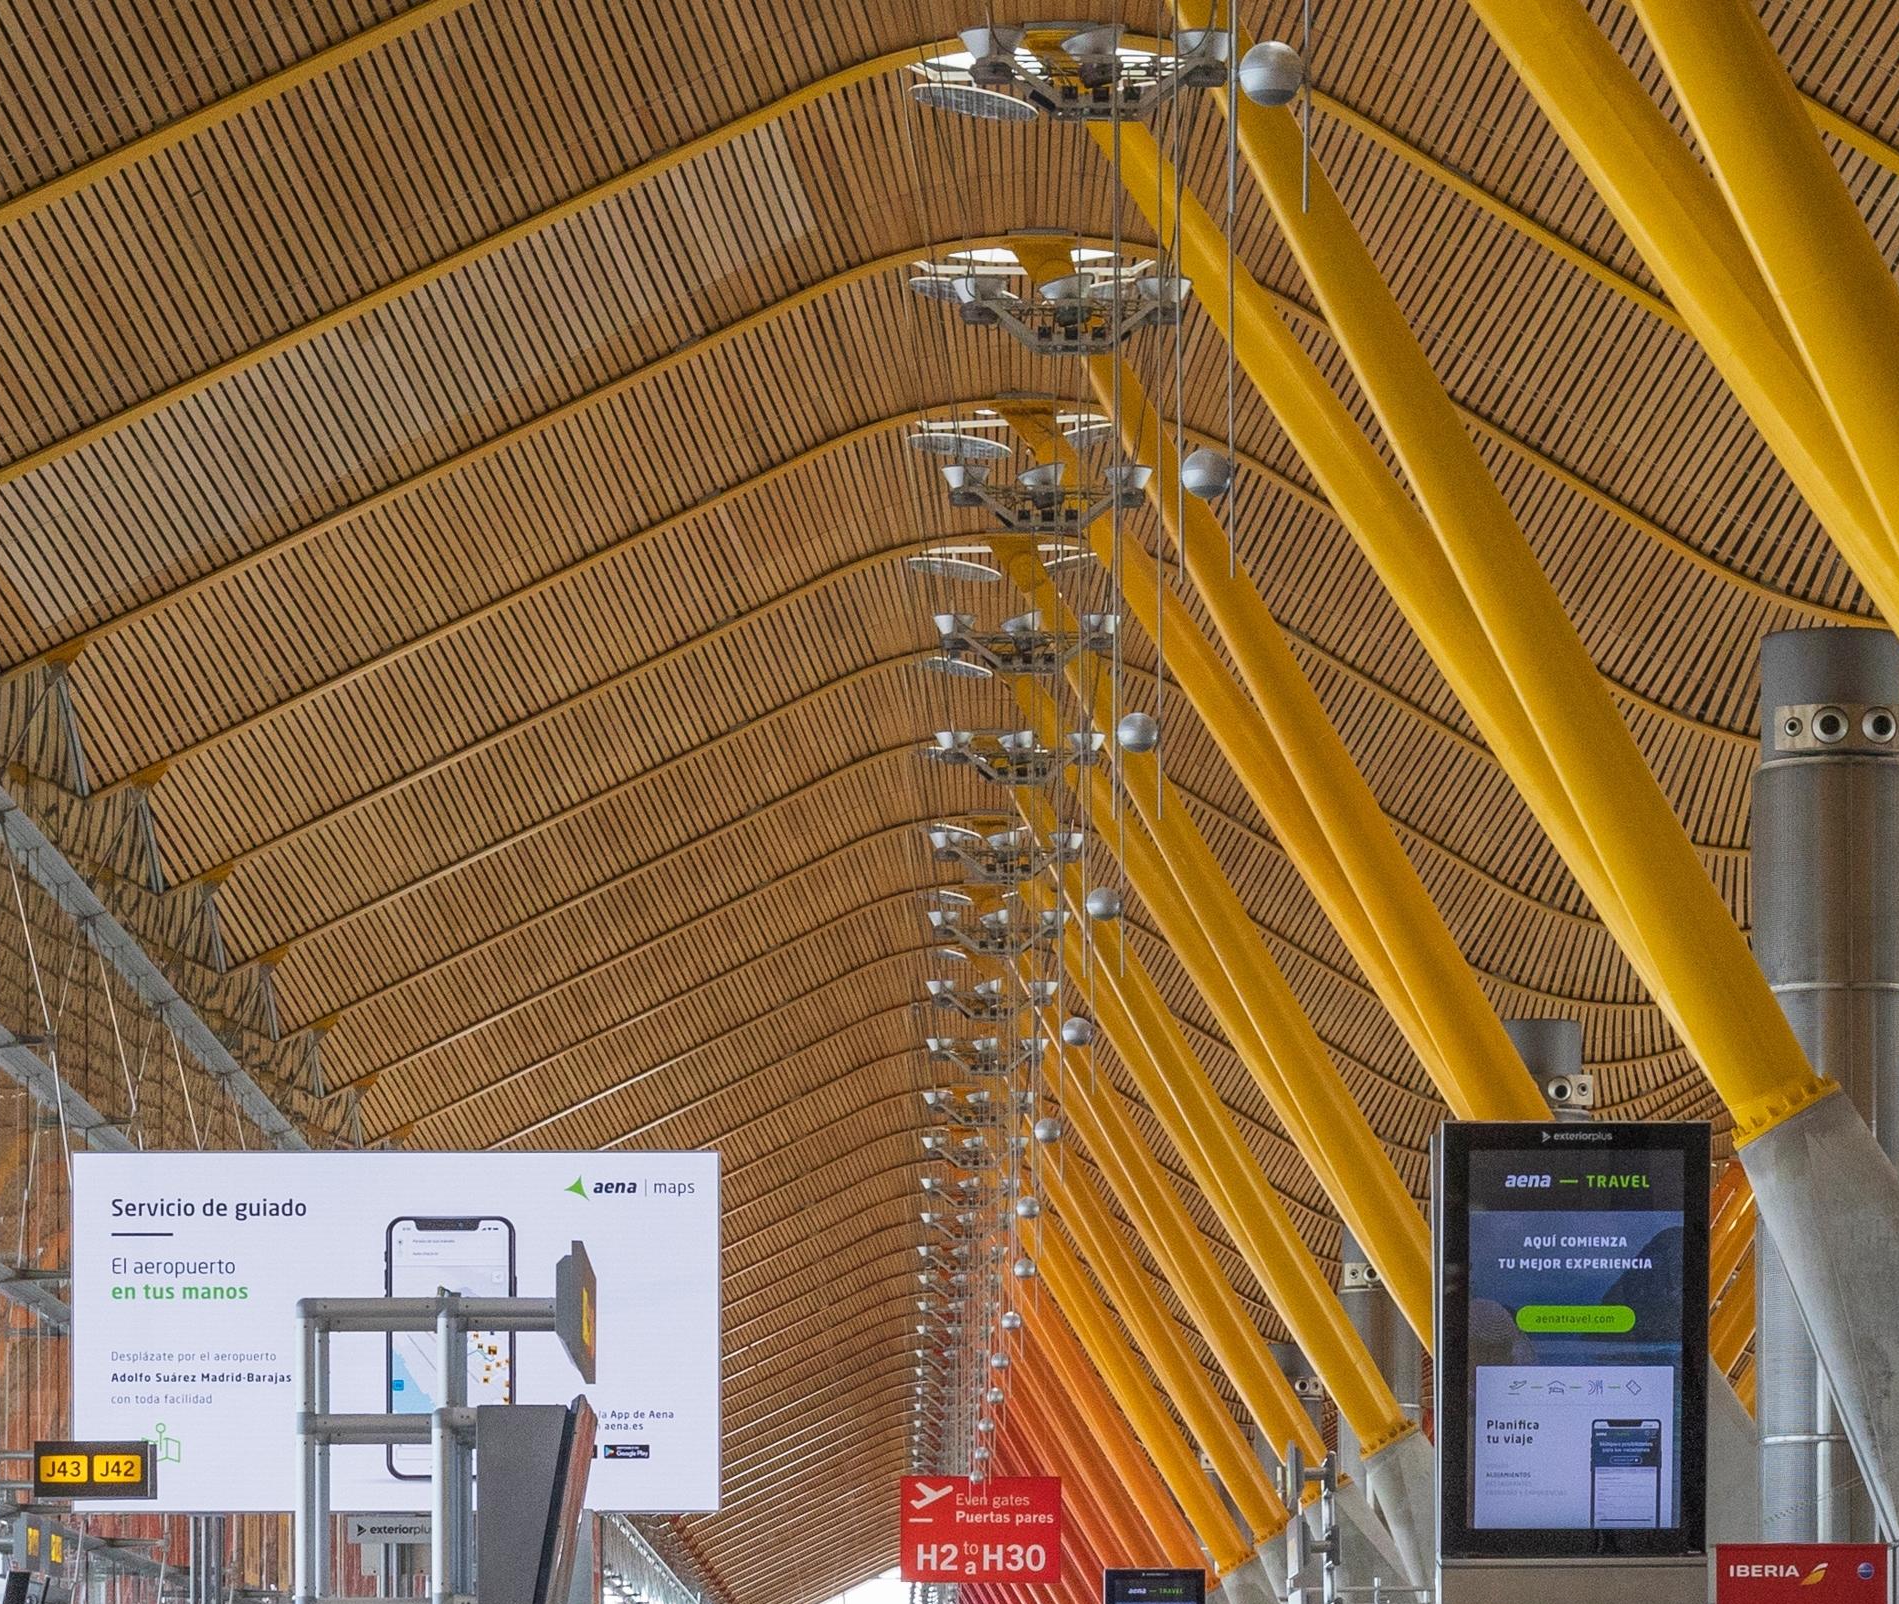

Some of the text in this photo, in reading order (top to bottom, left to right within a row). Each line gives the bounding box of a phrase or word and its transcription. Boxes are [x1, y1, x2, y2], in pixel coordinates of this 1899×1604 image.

[1553, 1131, 1613, 1142] exteriorplus
[1505, 1174, 1650, 1188] aena TRAVEL
[593, 1180, 695, 1197] aena maps
[111, 1198, 308, 1221] Servicio de guiado
[1523, 1234, 1628, 1249] AQUÍ COMIENZA
[111, 1258, 236, 1279] El aeropuerto
[1498, 1258, 1653, 1271] TU MEJOR EXPERIENCIA
[111, 1283, 249, 1300] en tus manos
[1535, 1314, 1615, 1324] aenatravel.com
[111, 1351, 277, 1362] Desplázate por el aeropuerto
[111, 1372, 292, 1384] Adolfo Suárez Madrid-Barajas
[111, 1393, 213, 1404] con toda facilidad
[611, 1410, 630, 1420] App
[633, 1410, 645, 1419] de
[649, 1410, 675, 1419] Aena
[604, 1423, 644, 1431] aena.es
[1486, 1419, 1540, 1430] Planifica
[1487, 1433, 1534, 1446] tu viaje
[46, 1460, 135, 1478] J43 J42
[955, 1493, 1030, 1509] Even gates
[955, 1510, 1054, 1526] Puertas pares
[369, 1524, 432, 1537] exteriorplu
[916, 1541, 1046, 1572] H2 to H30
[964, 1561, 977, 1575] a
[1729, 1565, 1800, 1577] IBERIA
